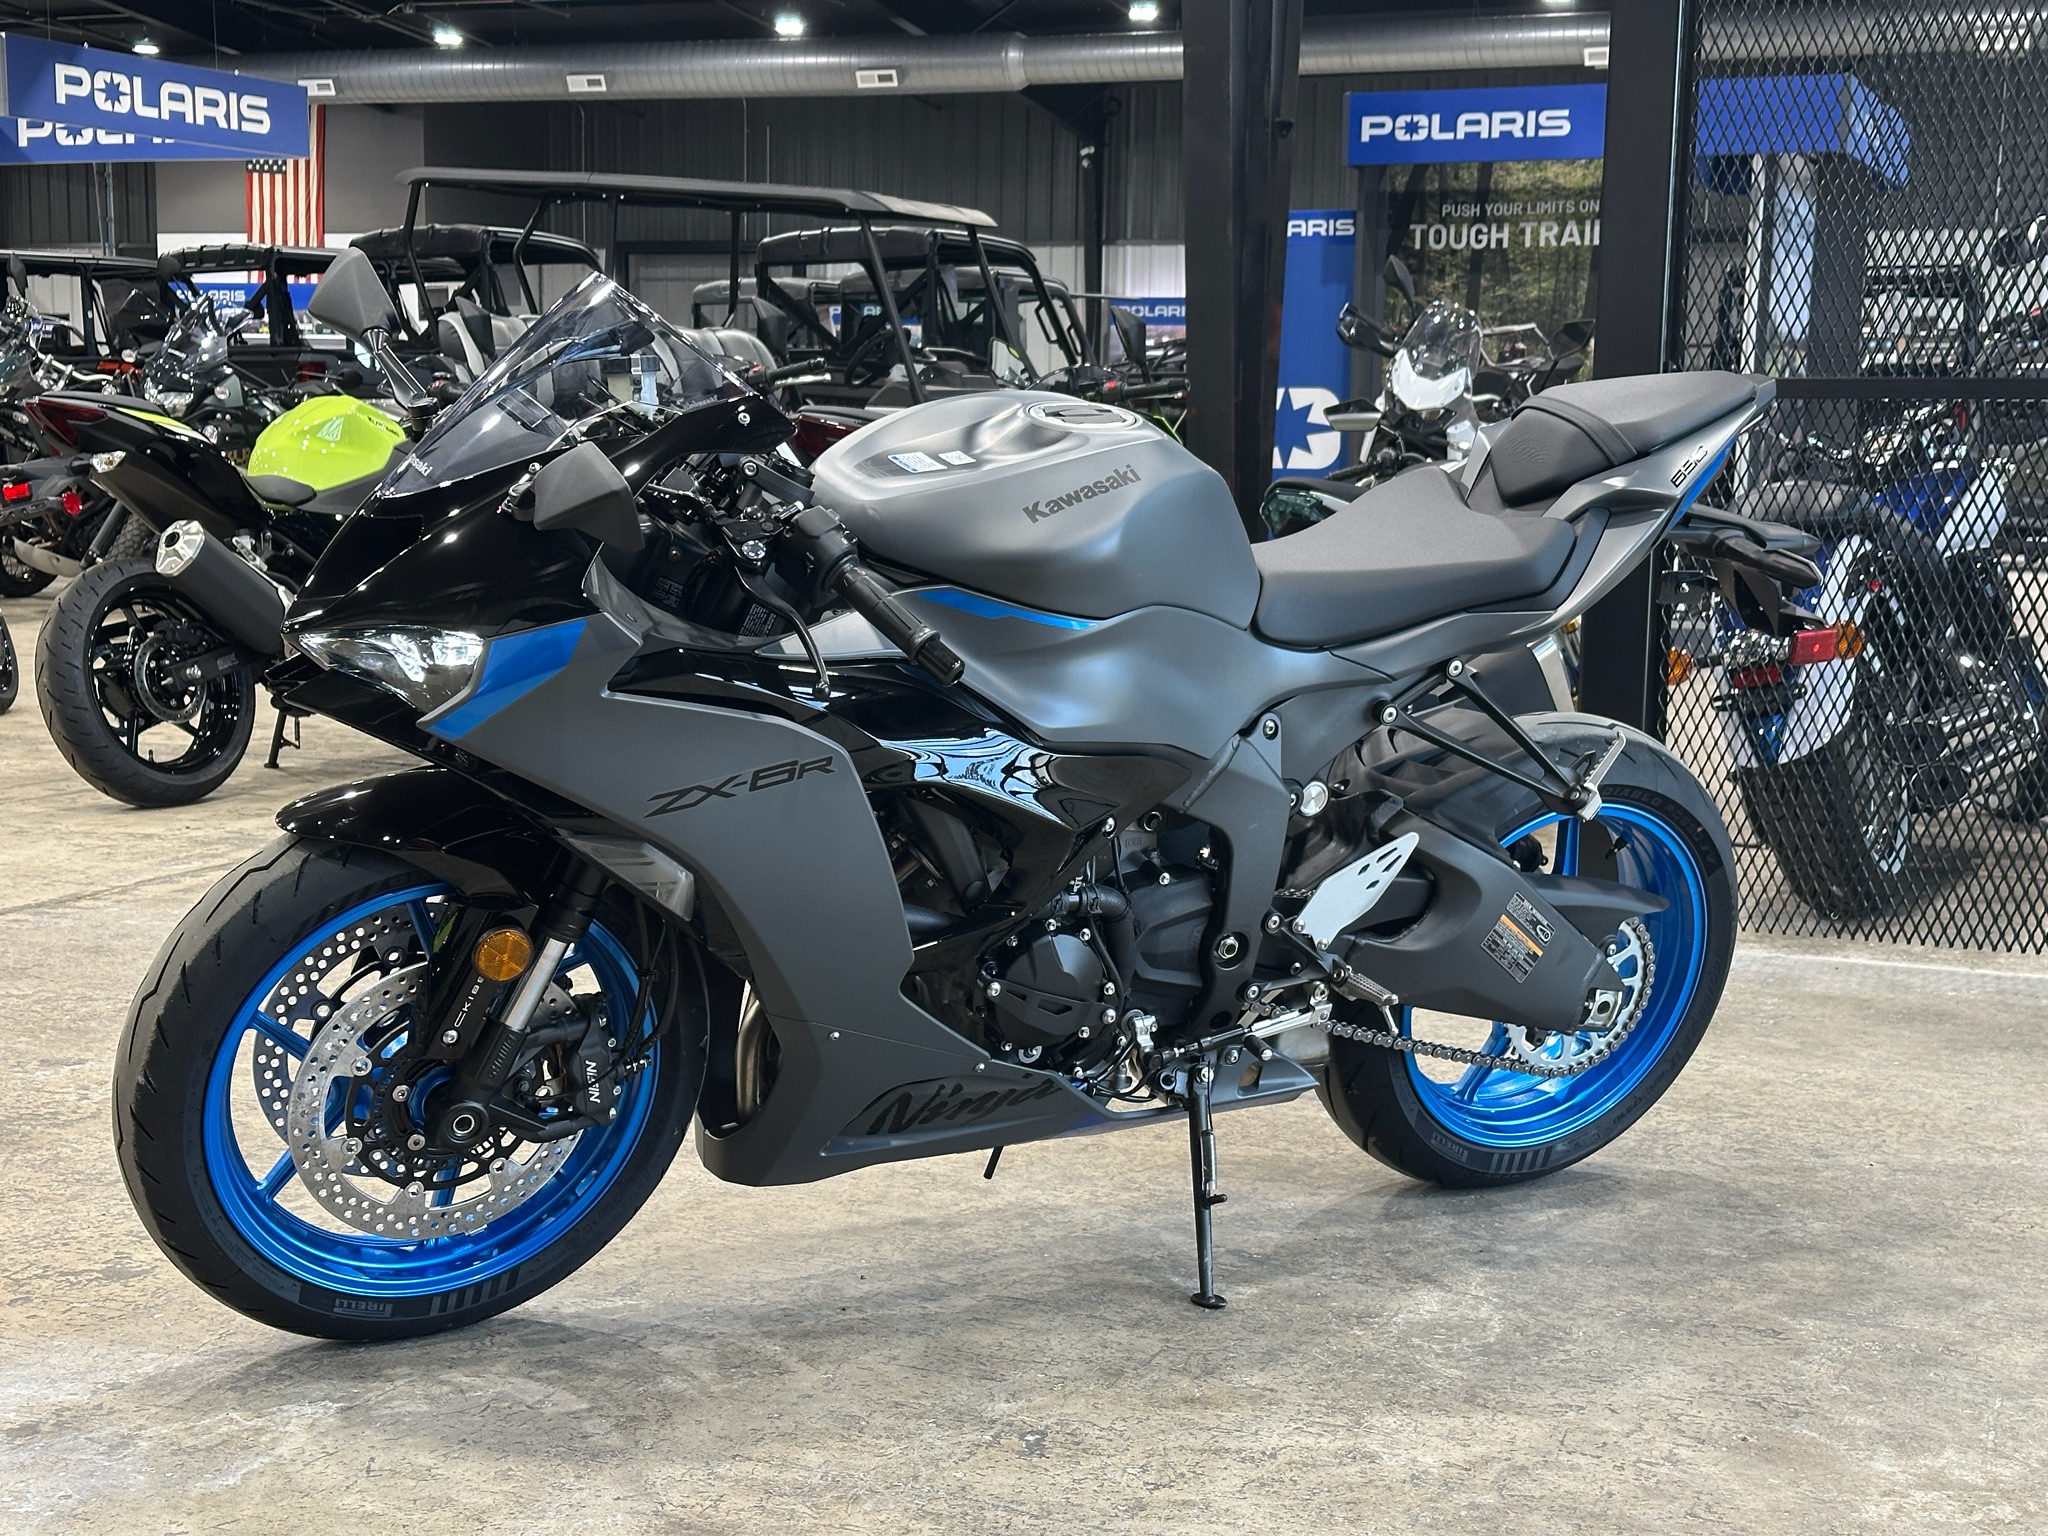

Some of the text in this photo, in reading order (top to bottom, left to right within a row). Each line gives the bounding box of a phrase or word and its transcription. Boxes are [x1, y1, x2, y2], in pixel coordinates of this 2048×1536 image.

[54, 62, 271, 135] POLARIS
[1360, 108, 1572, 143] POLARIS
[1442, 199, 1600, 217] PUSH YOUR LIMITS ON
[1286, 219, 1356, 238] ARIS
[1409, 222, 1510, 250] TOUGH
[1022, 464, 1142, 524] Kawasaki
[642, 755, 836, 819] ZX-6R
[866, 1073, 1064, 1136] Ninja
[333, 1298, 393, 1318] PIRELLI
